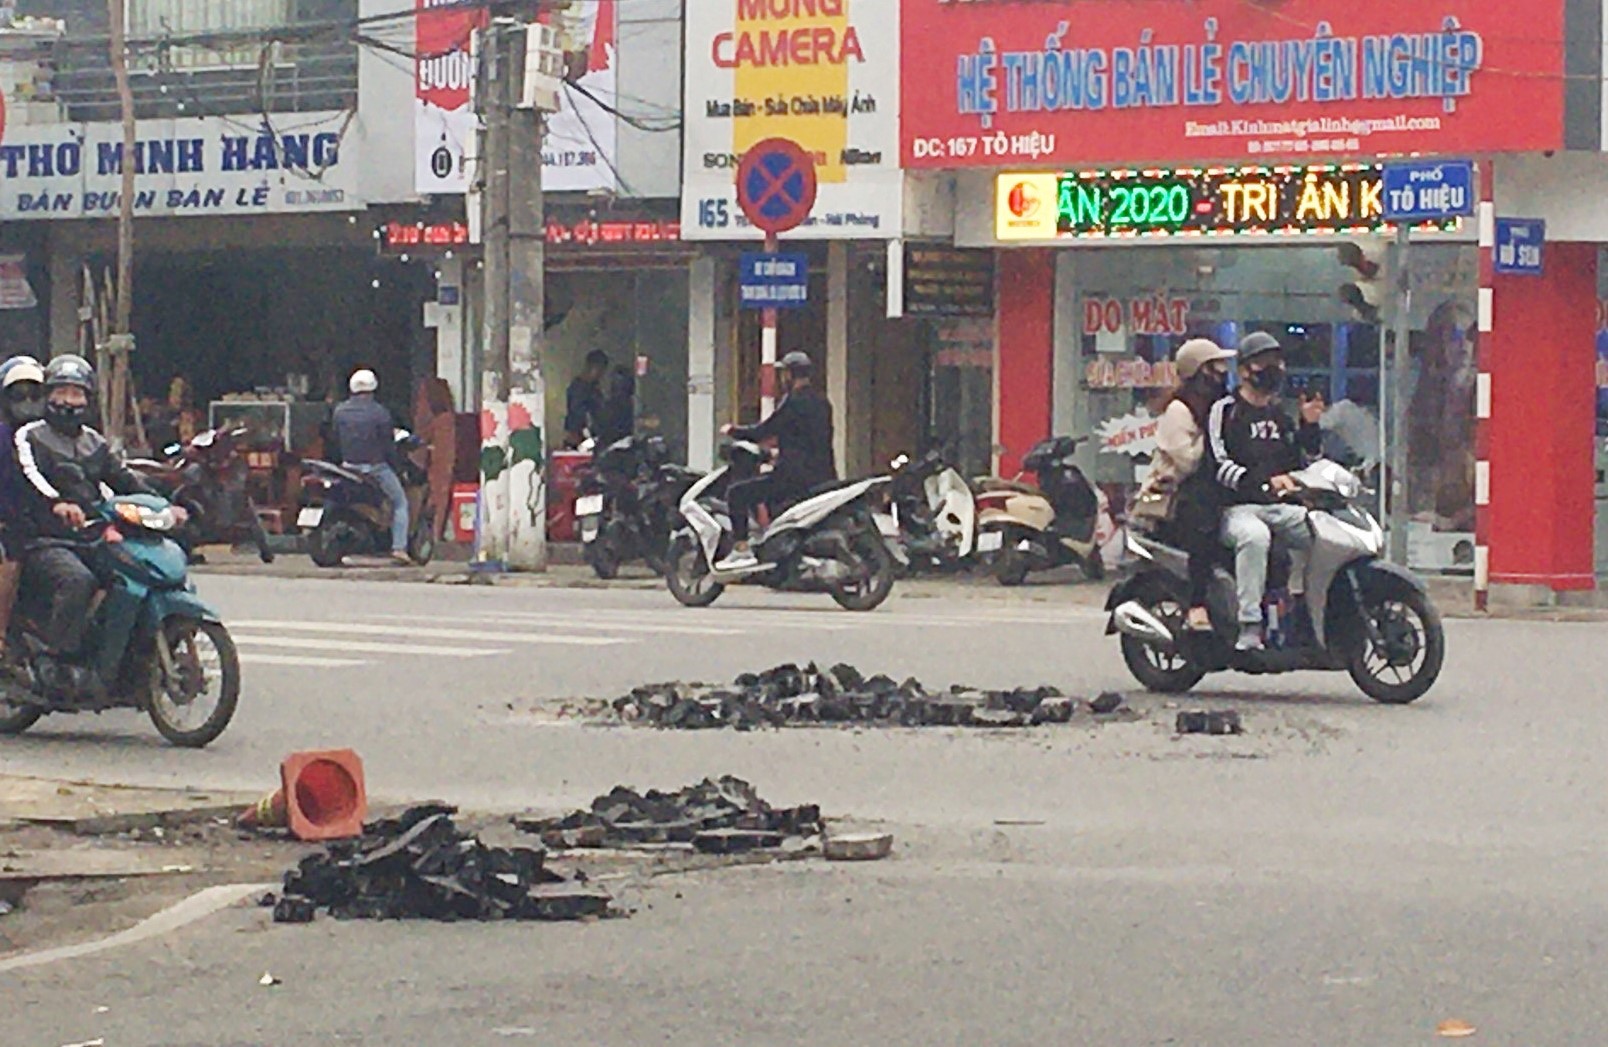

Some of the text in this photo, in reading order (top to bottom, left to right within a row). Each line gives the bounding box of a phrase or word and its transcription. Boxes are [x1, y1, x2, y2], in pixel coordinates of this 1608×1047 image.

[711, 26, 865, 68] CAMERA
[957, 15, 1483, 129] HỆ THỐNG BÁN LẺ CHUYÊN NGHIỆP
[97, 139, 204, 175] MINH
[947, 137, 977, 156] 167
[1011, 130, 1055, 159] HIỆU
[1410, 164, 1443, 182] PHỐ
[83, 190, 156, 211] BUN
[235, 180, 270, 206] LẺ
[1110, 185, 1189, 223] 2020
[1296, 173, 1349, 222] ÂN
[1390, 183, 1464, 212] TÔ HIỆU
[699, 198, 729, 228] 165
